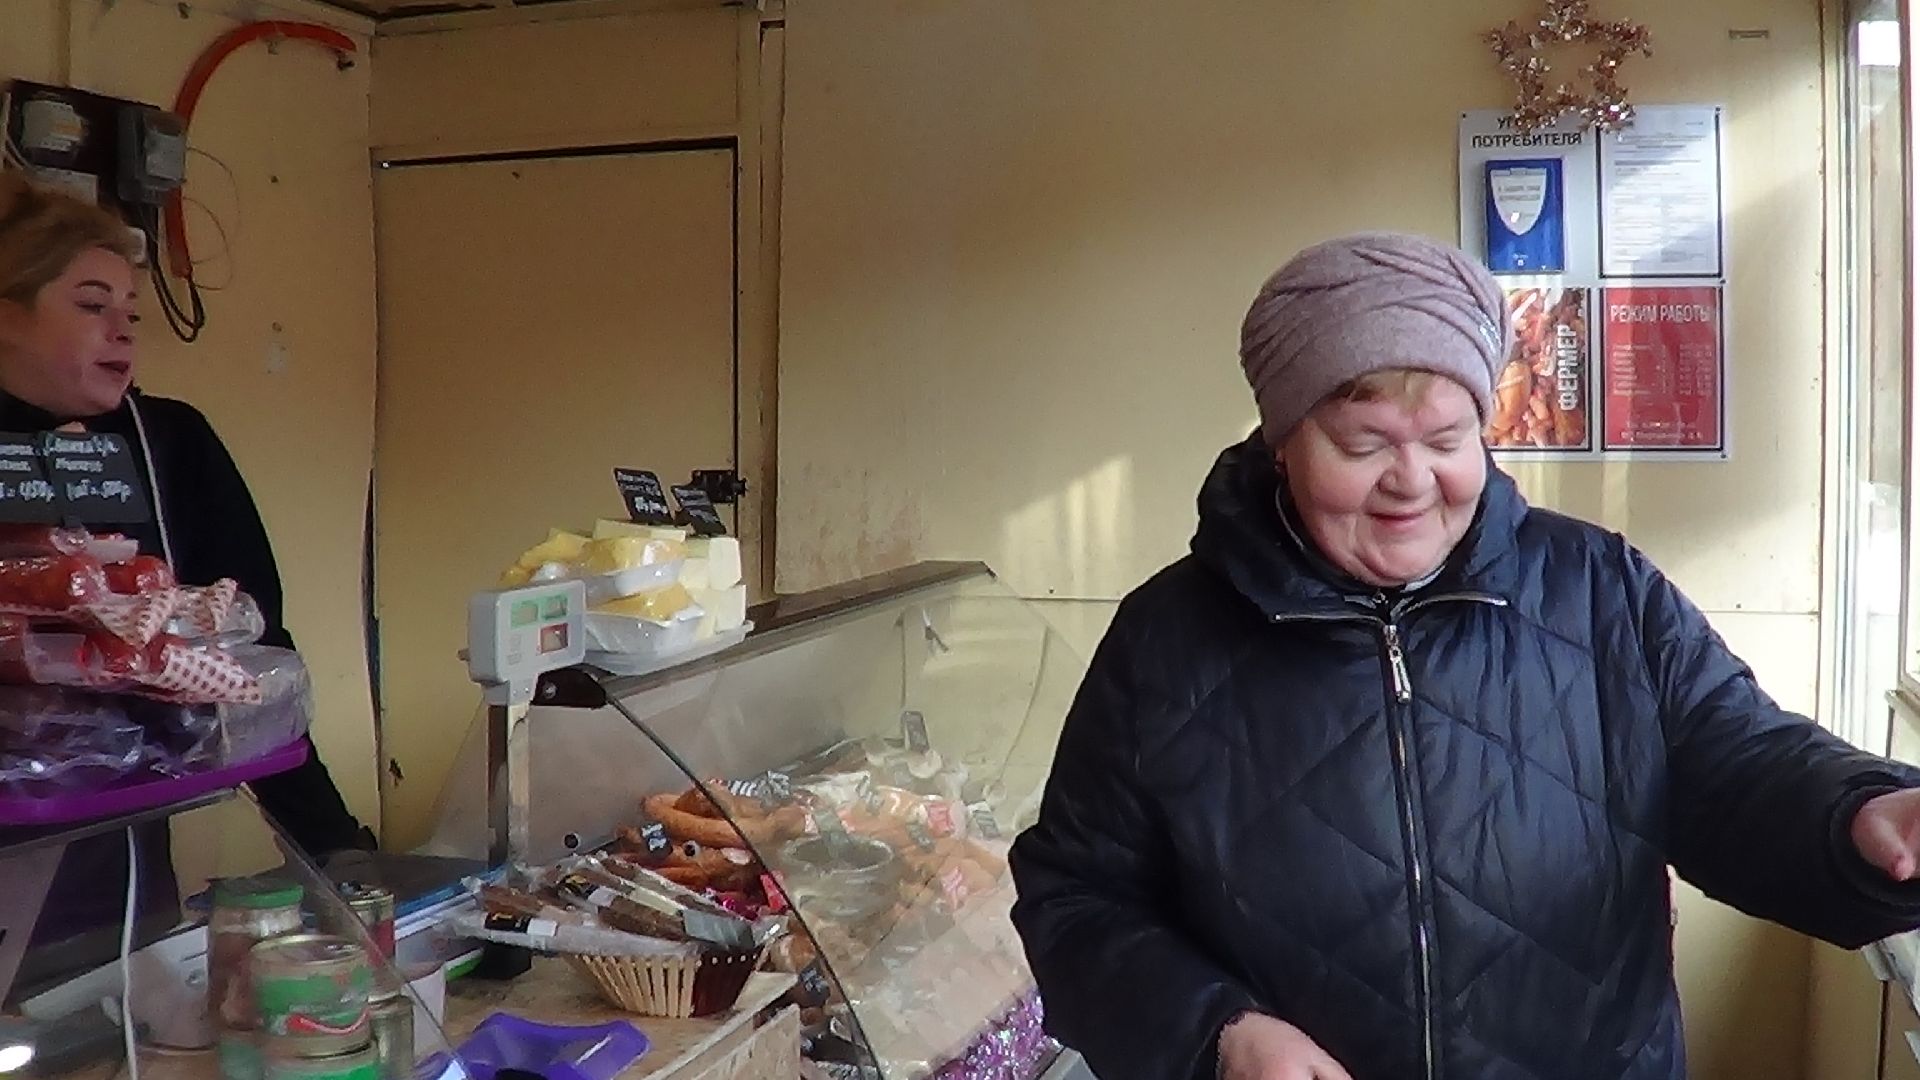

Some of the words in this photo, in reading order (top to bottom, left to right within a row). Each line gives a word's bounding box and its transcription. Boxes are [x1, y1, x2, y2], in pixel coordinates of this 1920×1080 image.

[1472, 132, 1583, 148] ПОТРЕБИТЕЛЯ
[1610, 303, 1658, 323] РЕЖИМ
[1660, 303, 1712, 323] РАБОТЫ
[1556, 324, 1579, 411] ФЕРМЕР
